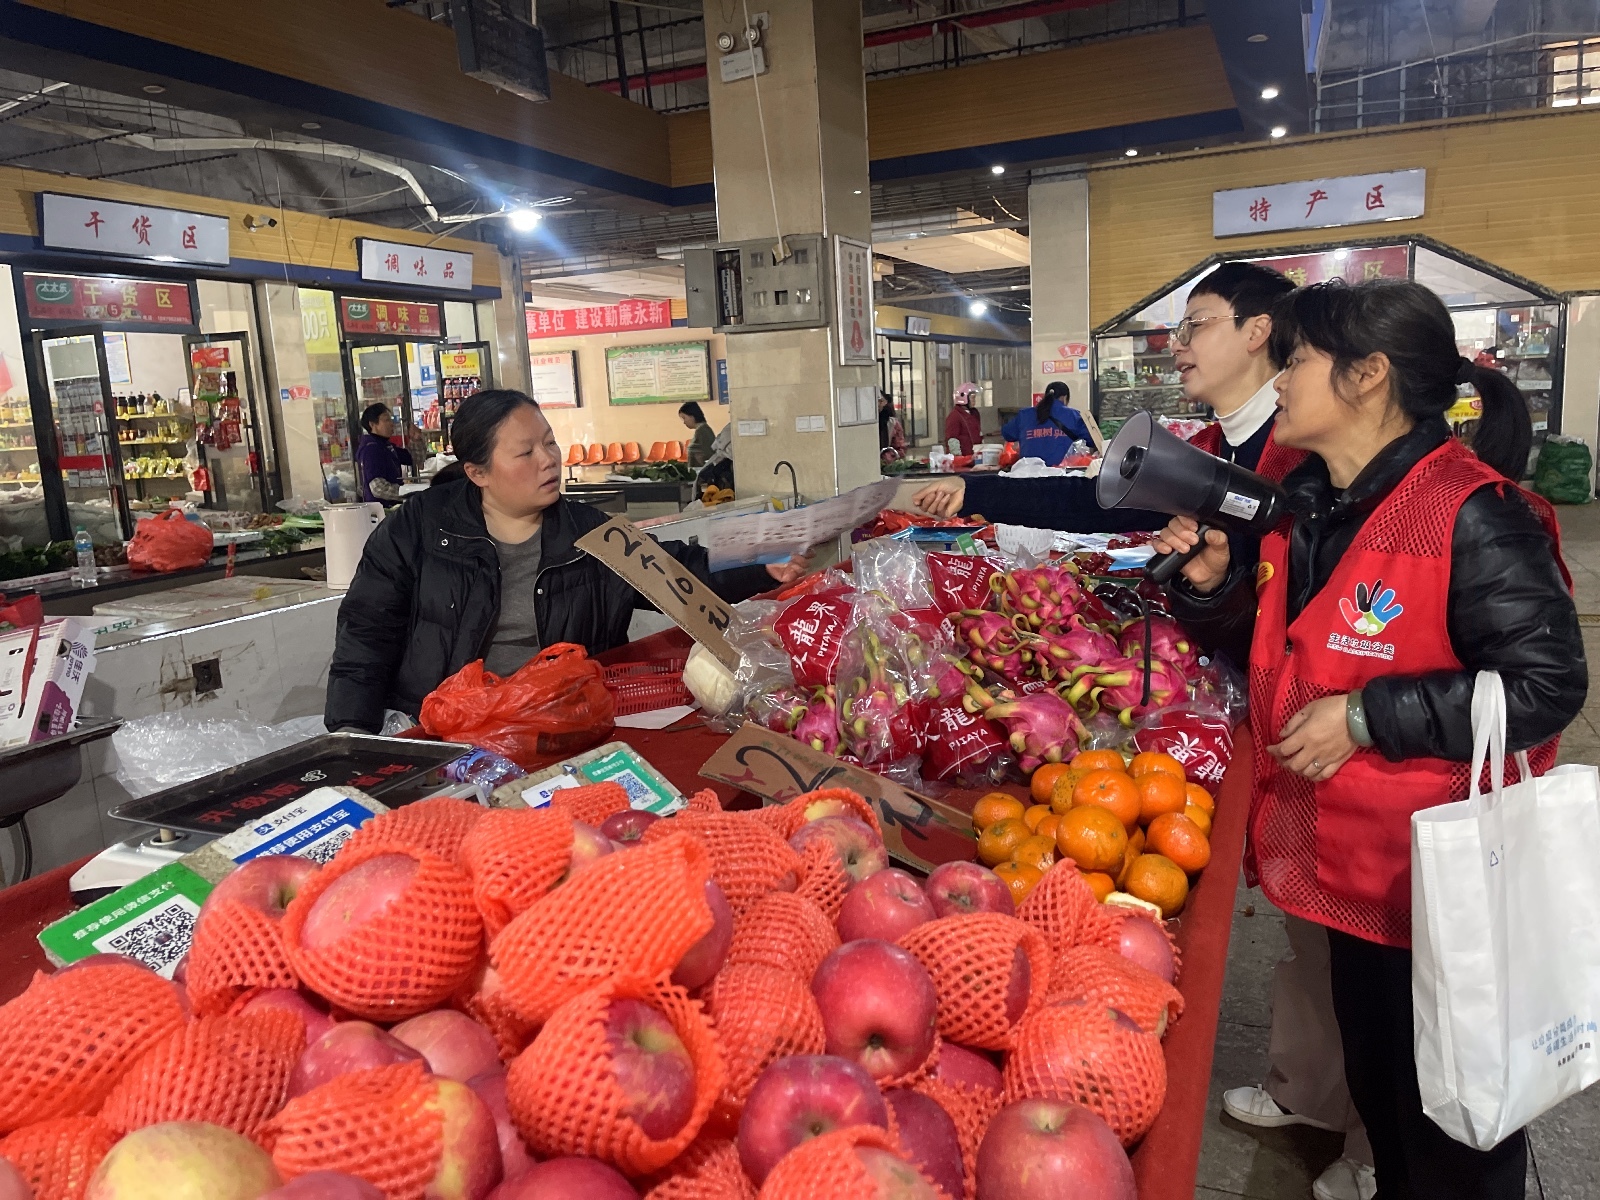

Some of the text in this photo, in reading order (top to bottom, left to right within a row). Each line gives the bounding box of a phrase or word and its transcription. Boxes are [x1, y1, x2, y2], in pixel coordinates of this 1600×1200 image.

[1249, 184, 1385, 222] 特产区
[84, 211, 198, 249] 干货区
[384, 253, 455, 279] 调味品
[84, 283, 173, 308] 干货区
[110, 305, 118, 315] 5
[376, 304, 429, 323] 调味品
[575, 302, 663, 330] 建设勤廉永新
[972, 566, 988, 592] PITAYA
[816, 619, 838, 657] PITAYA
[1328, 632, 1395, 655] 生活垃圾分类
[71, 659, 84, 684] 佳沃
[948, 728, 989, 751] PITAYA
[272, 806, 307, 827] 支付宝
[72, 881, 176, 941] 推荐使用微信支付
[1531, 1014, 1577, 1050] 让垃圾分类成
[1545, 1020, 1598, 1056] 低碳生活时尚
